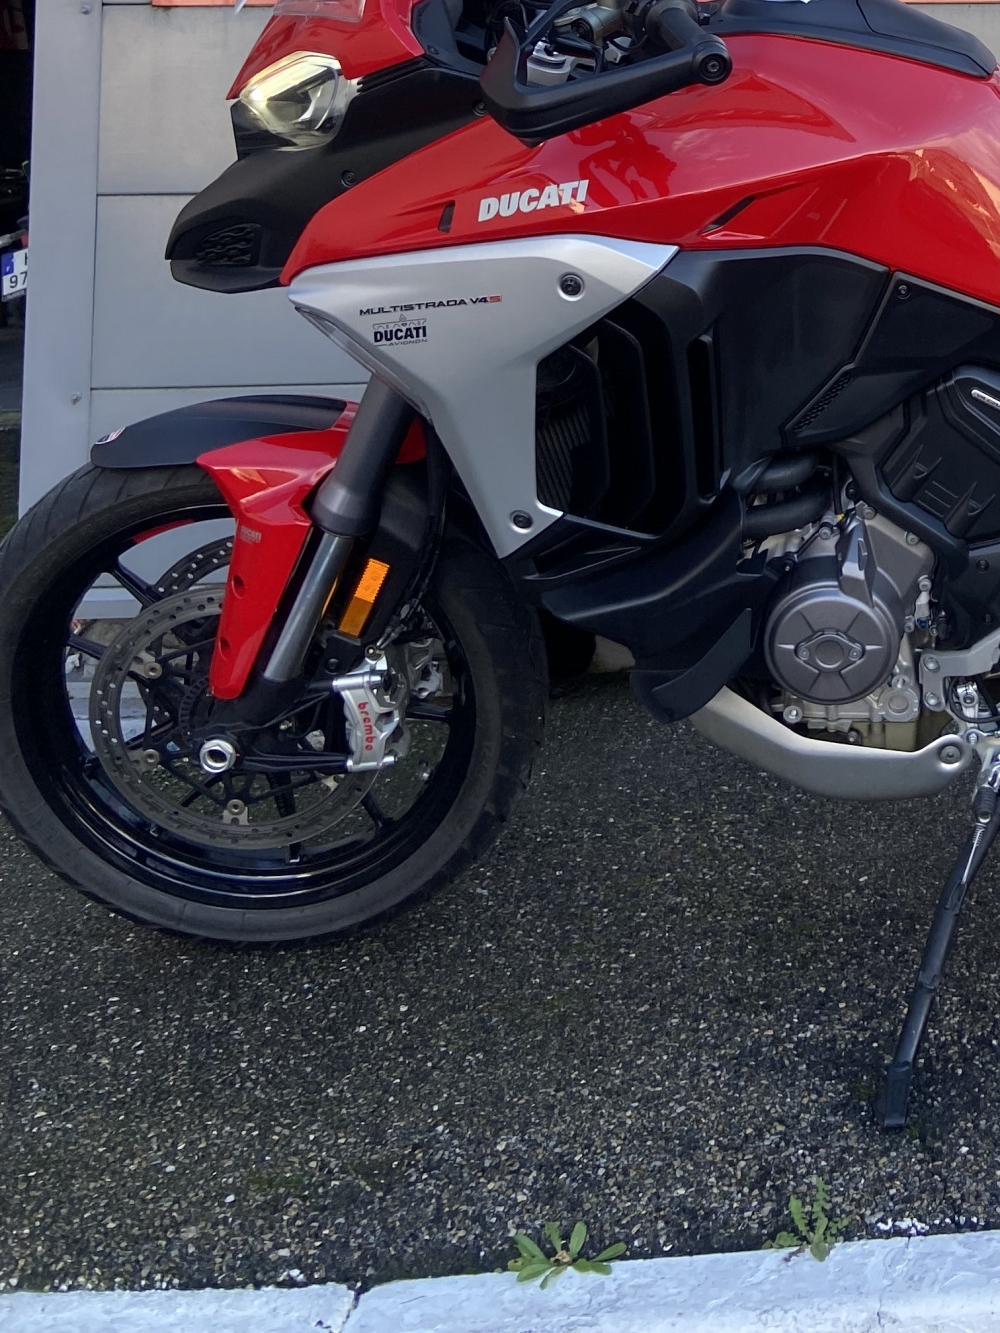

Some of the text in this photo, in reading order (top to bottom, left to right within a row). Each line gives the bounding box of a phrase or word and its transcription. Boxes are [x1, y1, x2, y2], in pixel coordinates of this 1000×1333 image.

[478, 179, 589, 222] DUCATI
[359, 298, 467, 316] MULTISTRADA
[374, 326, 427, 343] DUCATI
[357, 701, 377, 752] brembo
